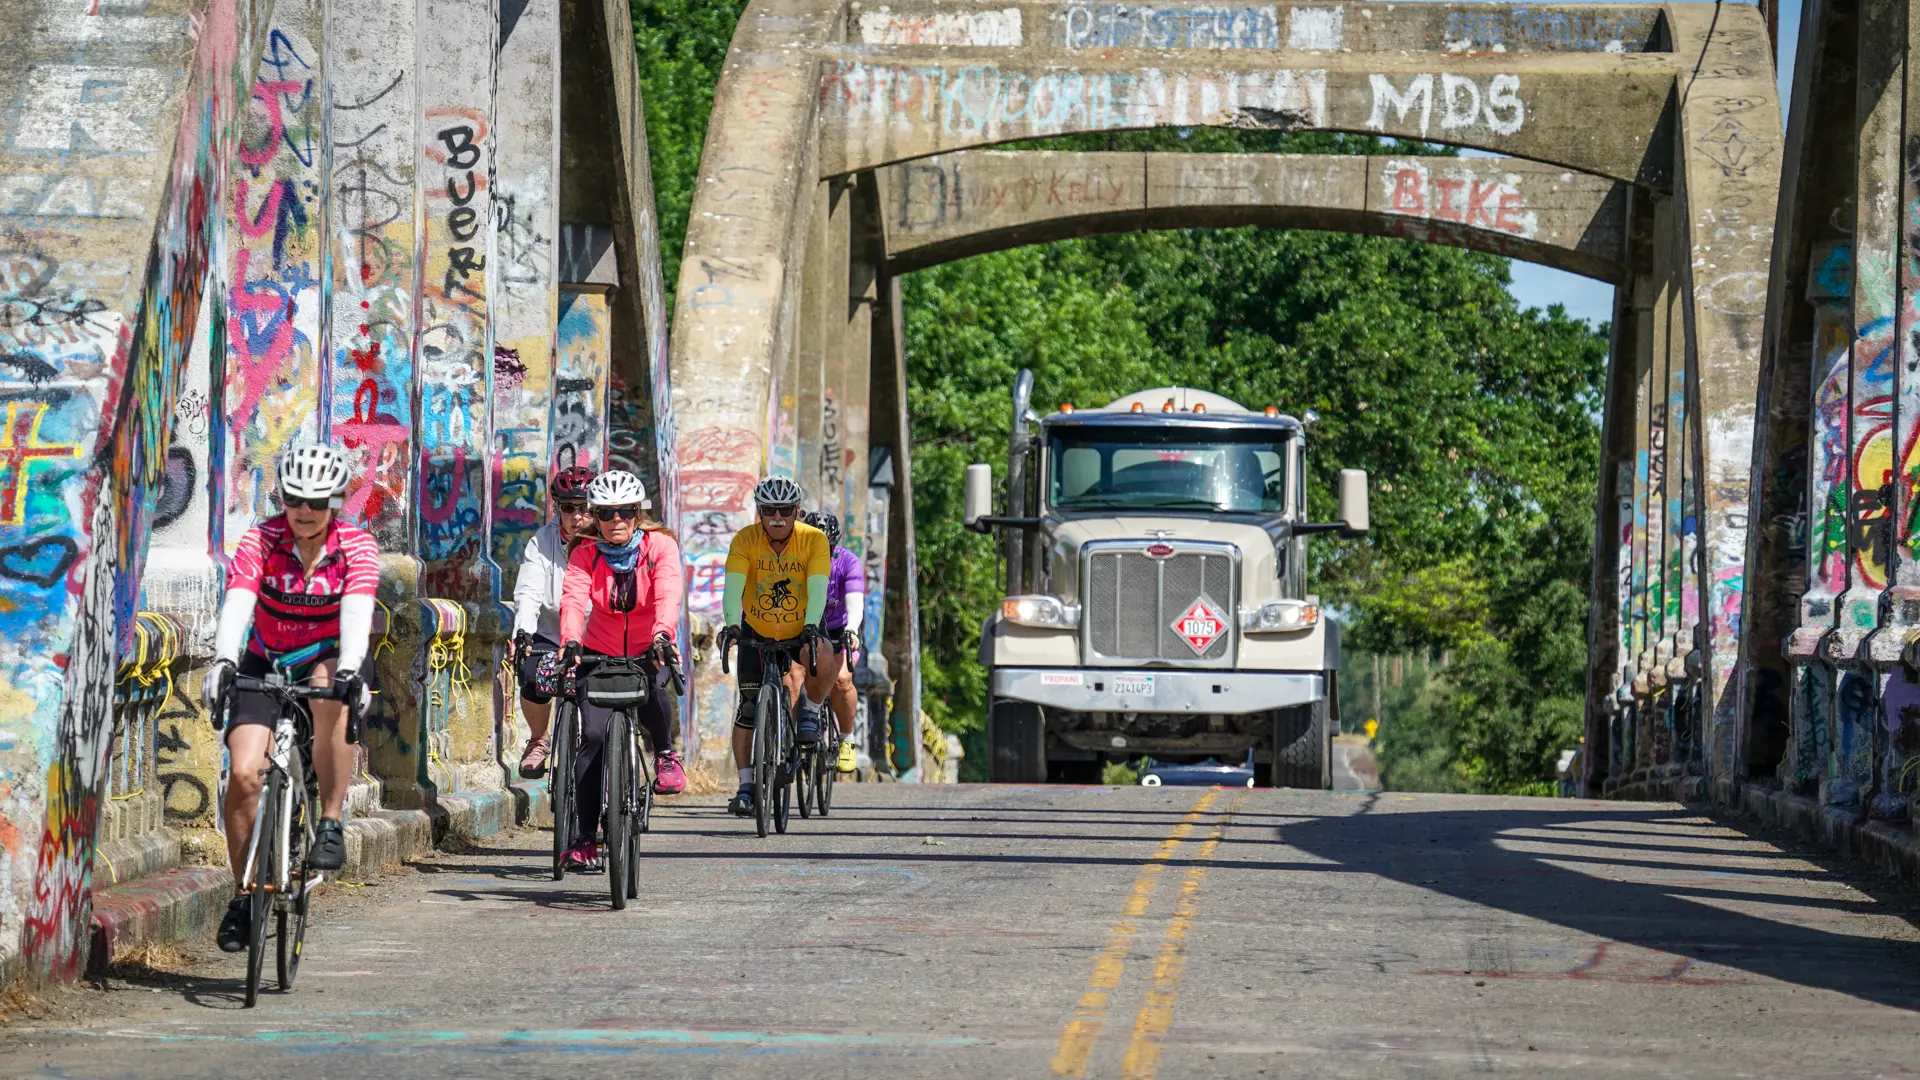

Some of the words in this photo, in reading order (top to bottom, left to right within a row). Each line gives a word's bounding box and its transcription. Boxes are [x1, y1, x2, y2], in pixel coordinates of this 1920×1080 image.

[1365, 71, 1525, 138] MDS
[1393, 167, 1527, 234] BIKE
[778, 560, 805, 573] MAN
[281, 593, 328, 606] CYCOLOGY
[1187, 621, 1213, 635] 1075
[1196, 638, 1204, 647] 2
